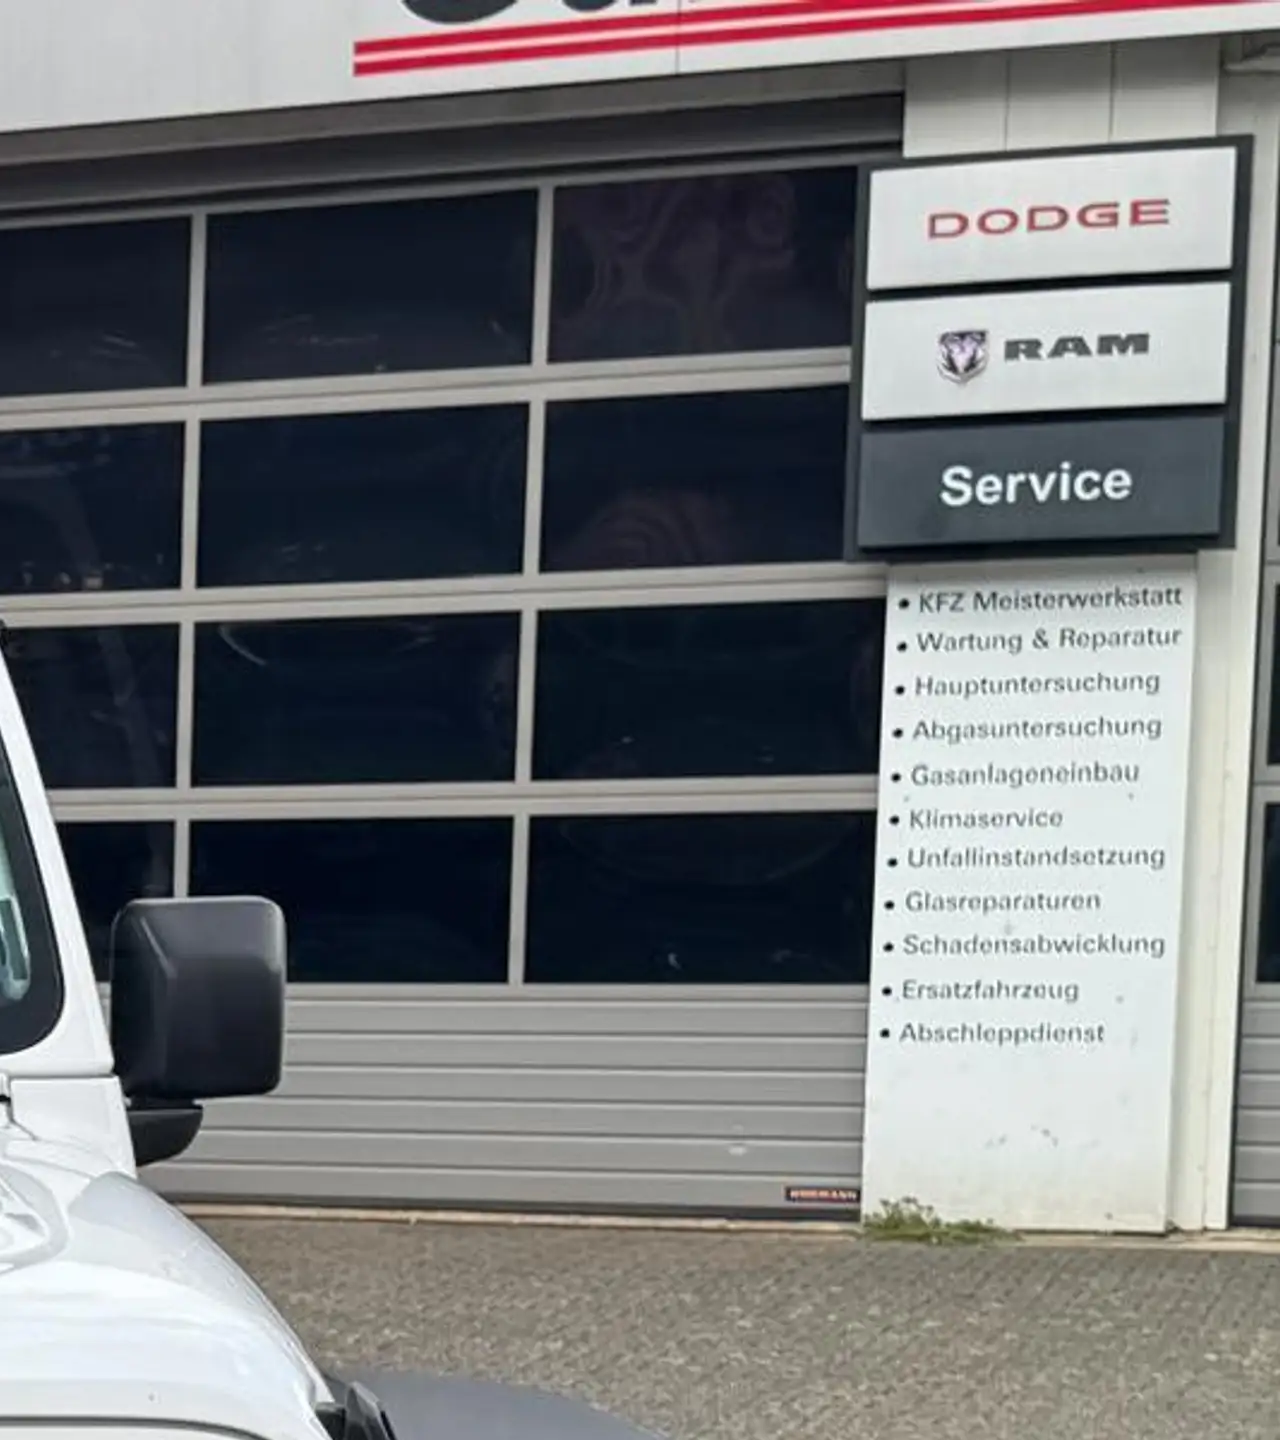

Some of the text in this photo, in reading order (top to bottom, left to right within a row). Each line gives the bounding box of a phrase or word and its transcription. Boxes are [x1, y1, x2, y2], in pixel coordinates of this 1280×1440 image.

[926, 199, 1171, 240] DODGE
[1002, 333, 1151, 361] RAM
[938, 462, 1133, 509] Service
[919, 586, 1182, 612] KFZ Meisterwerkstatt
[916, 626, 1182, 654] Wartung & Reparatur
[914, 671, 1160, 697] Hauptuntersuchung
[912, 716, 1163, 745] Abgasuntersuchung
[910, 762, 1140, 789] Gasanlageneinbau
[908, 809, 1064, 830] Klimaservice
[907, 846, 1166, 871] Unfallinstandsetzung
[905, 889, 1102, 914] Glasreparaturen
[902, 935, 1166, 959] Schadensabwicklung
[901, 977, 1080, 1002] Ersatzfahrzeug
[899, 1023, 1105, 1048] Abschleppdienst
